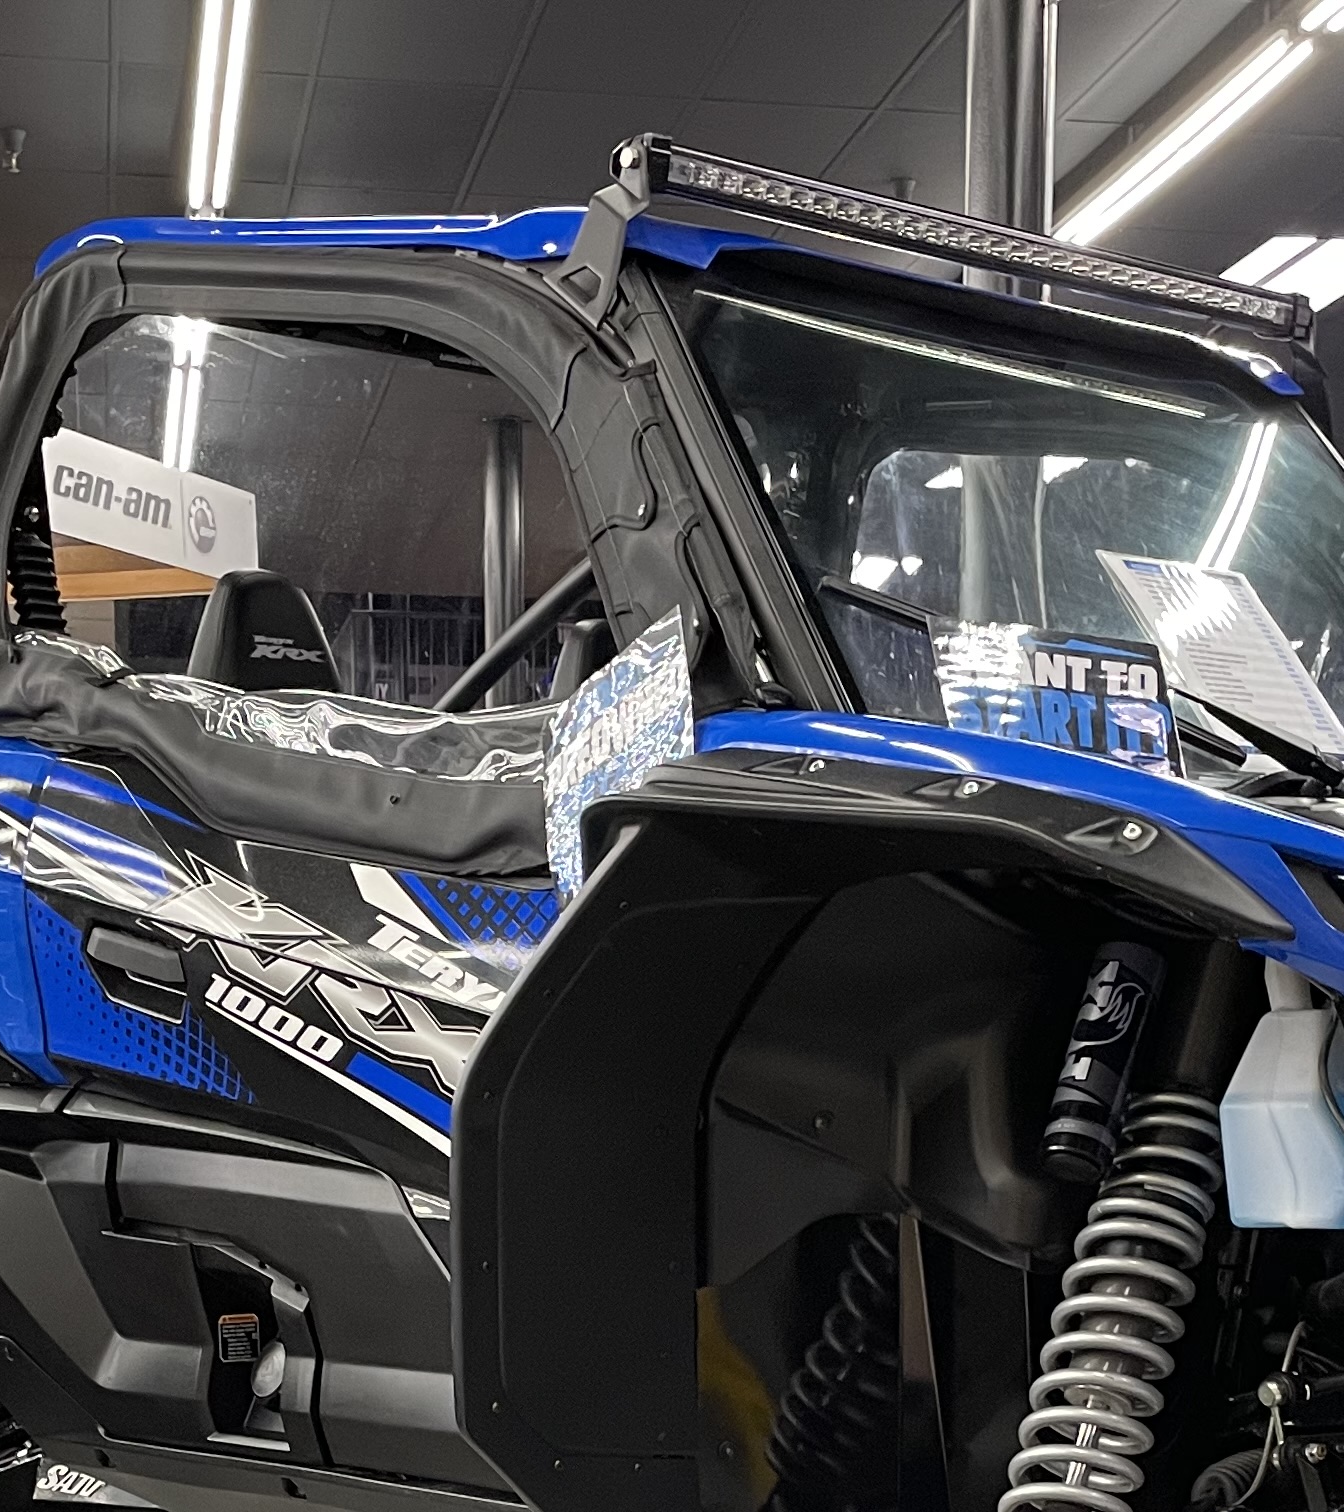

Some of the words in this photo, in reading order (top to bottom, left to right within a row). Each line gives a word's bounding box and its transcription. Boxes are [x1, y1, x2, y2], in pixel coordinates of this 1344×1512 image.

[52, 464, 172, 529] can-am
[250, 644, 325, 664] KRX
[1100, 658, 1159, 701] TO
[138, 850, 487, 1098] KRX
[204, 973, 344, 1063] 1000
